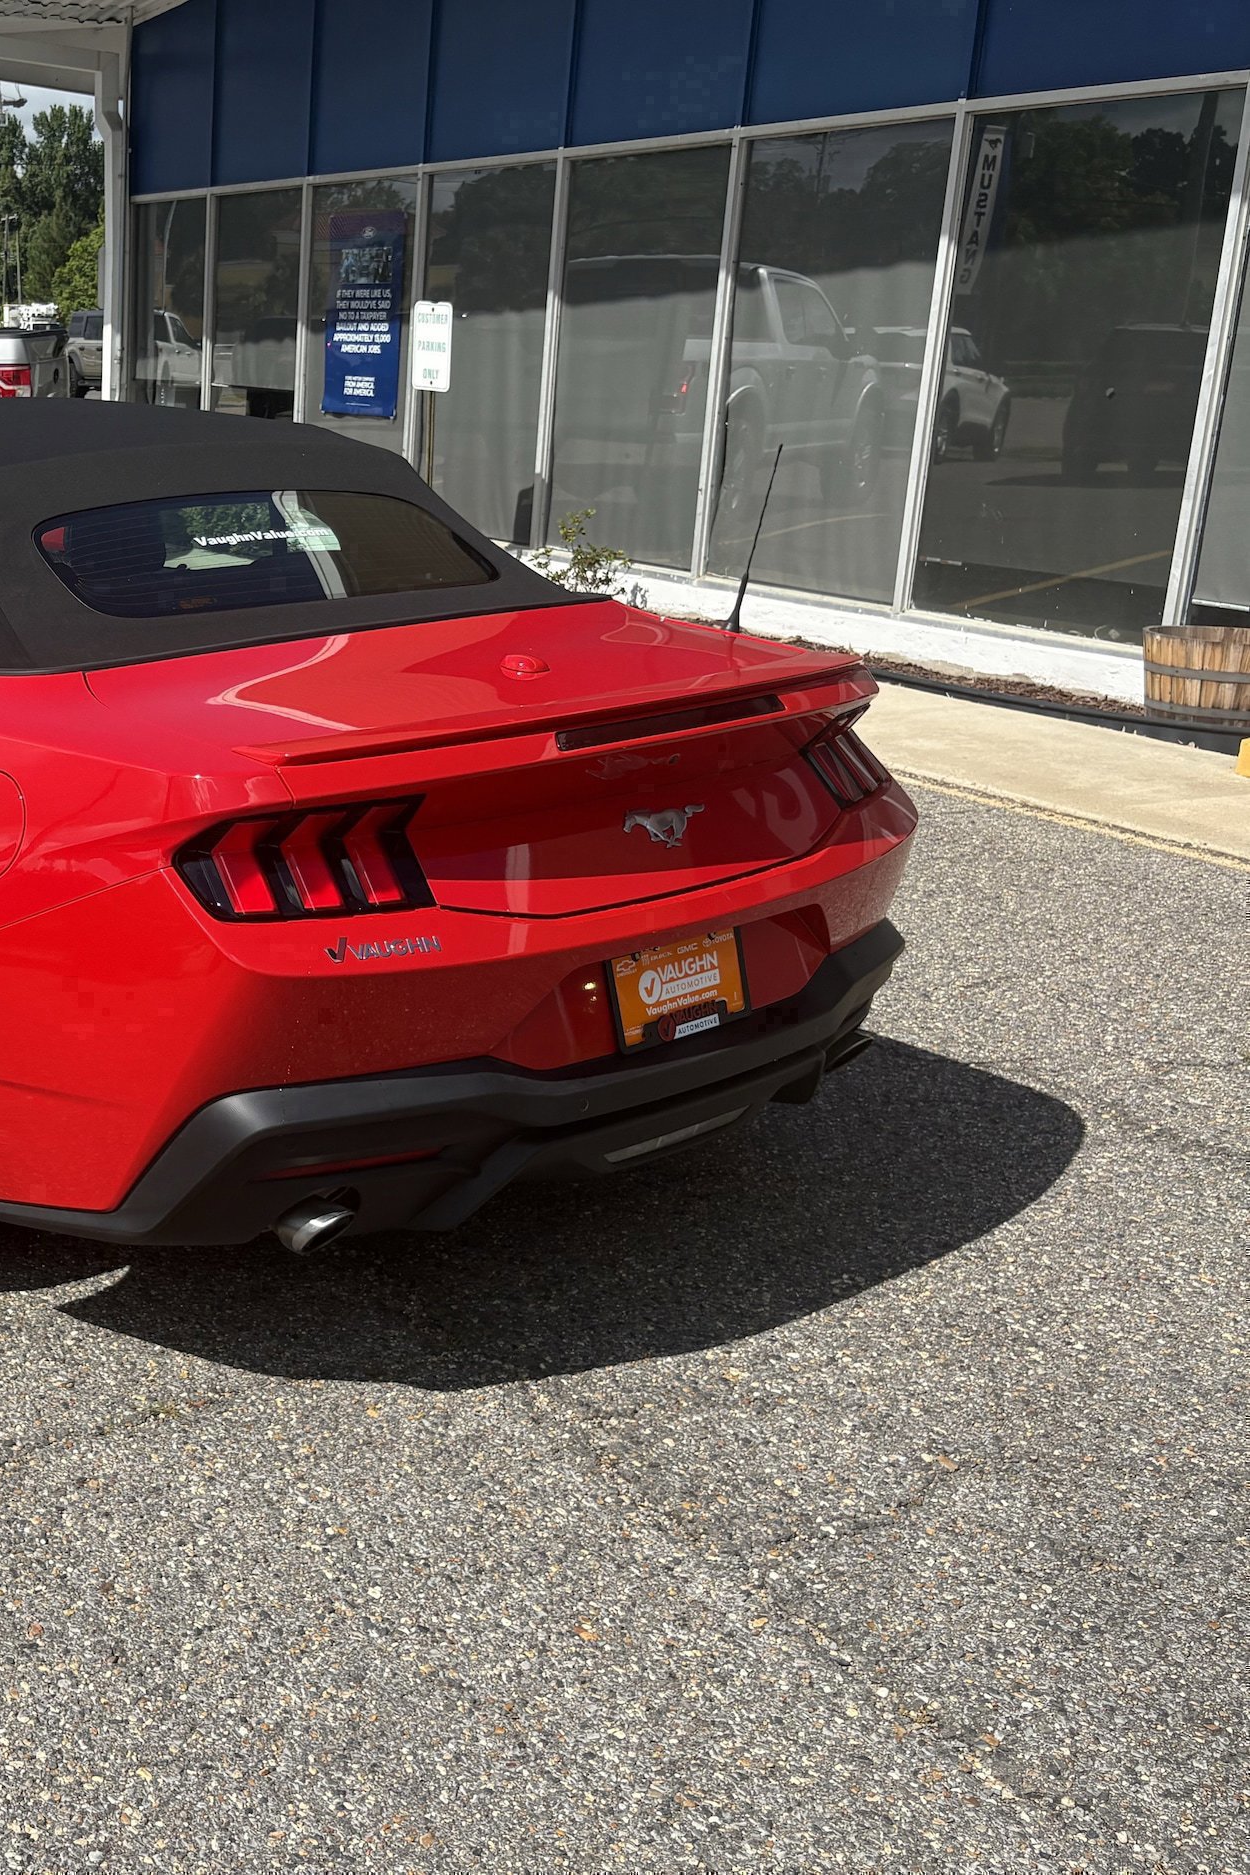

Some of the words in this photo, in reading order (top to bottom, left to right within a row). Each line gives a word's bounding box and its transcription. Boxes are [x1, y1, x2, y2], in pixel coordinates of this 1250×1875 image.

[342, 290, 354, 298] THEY
[355, 290, 370, 298] WERE
[371, 290, 382, 298] LIKE
[336, 300, 349, 309] THEY
[350, 300, 377, 309] WOULD'VE
[378, 300, 391, 309] SAID
[339, 311, 347, 320] NO
[348, 311, 355, 320] TO
[360, 311, 387, 320] TAXPAYER
[418, 313, 448, 324] CUSTOMER
[336, 322, 357, 331] BAILOUT
[358, 323, 369, 331] AND
[370, 323, 389, 331] ADDED
[341, 344, 367, 353] AMERICAN
[417, 340, 446, 352] PARKING
[423, 368, 439, 380] ONLY
[193, 529, 328, 546] VaughnValue.com
[347, 936, 442, 960] VAUGHN
[677, 943, 698, 955] GMC
[657, 951, 719, 982] VAUGHN
[665, 973, 718, 995] AUTOMOTIVE
[646, 989, 718, 1016] VaughnValue.com
[672, 1002, 718, 1024] VAUGHN
[677, 1017, 718, 1035] AUTOMOTIVE
